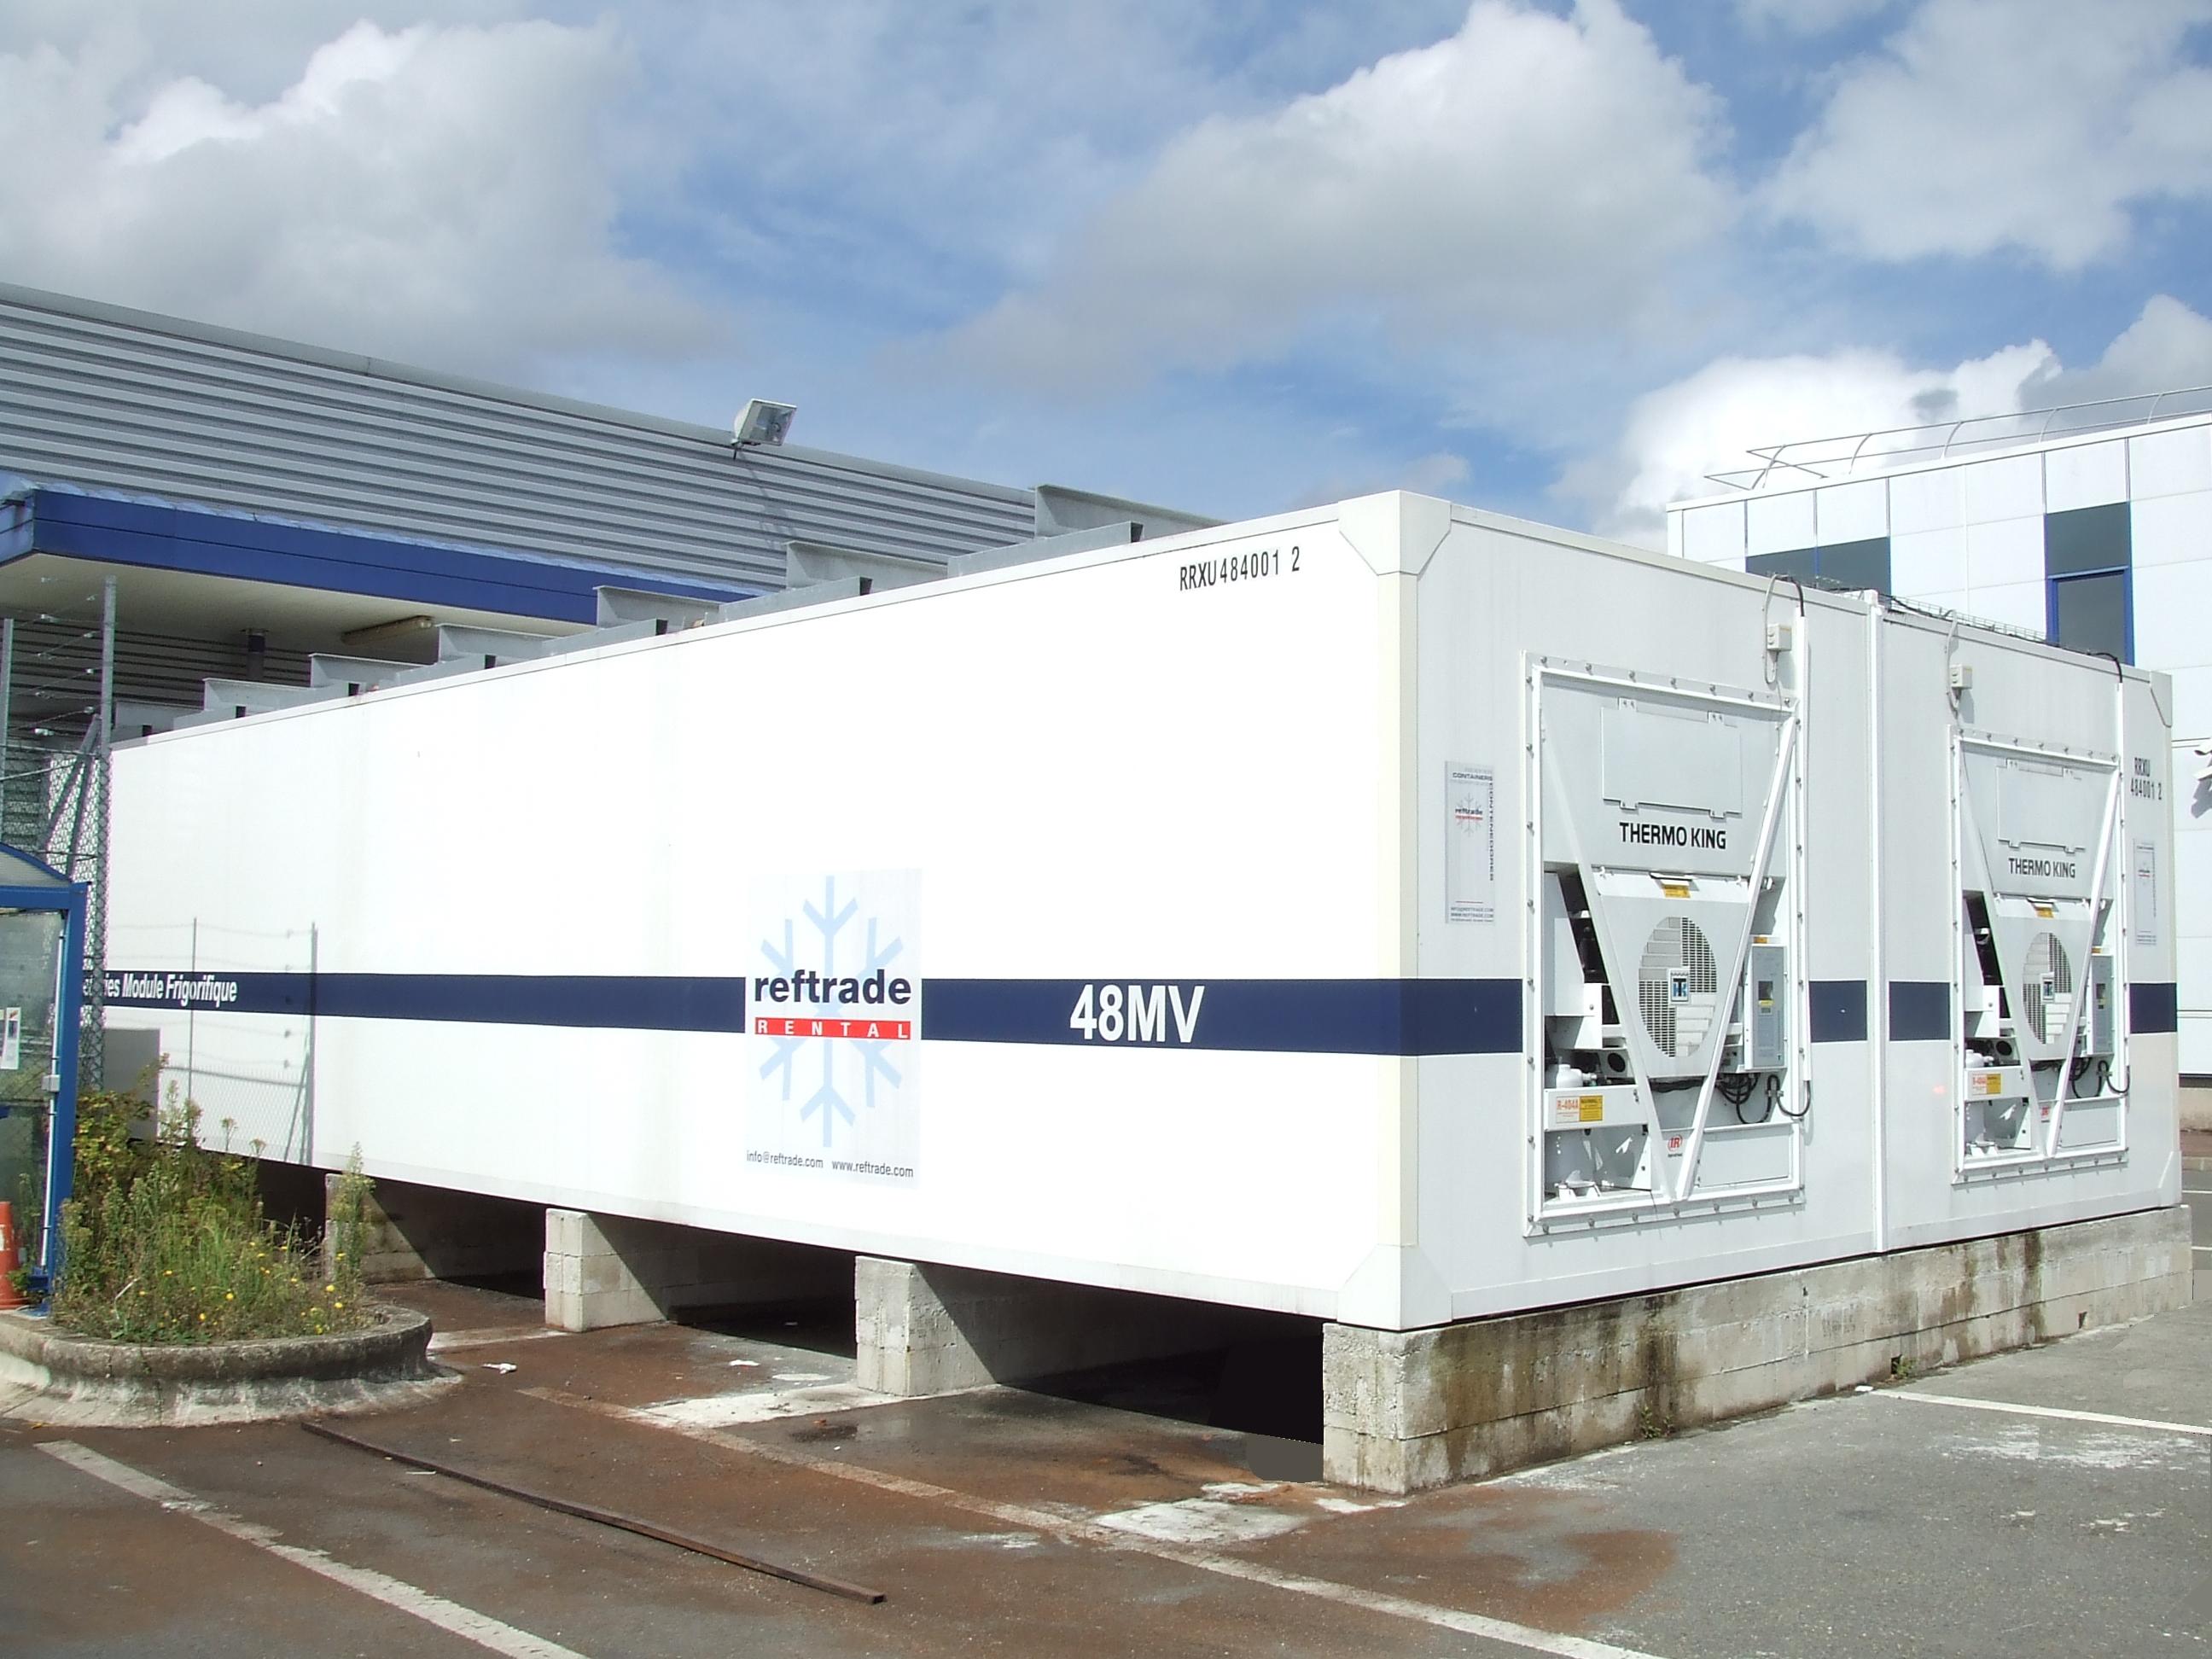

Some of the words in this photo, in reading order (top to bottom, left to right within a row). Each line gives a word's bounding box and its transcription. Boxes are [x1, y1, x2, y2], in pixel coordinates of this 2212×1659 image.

[1179, 560, 1216, 591] RRXU
[1220, 549, 1279, 584] 484001
[1291, 545, 1301, 573] 2
[1619, 821, 1688, 847] THERMO
[1690, 827, 1726, 850] KING
[2008, 857, 2052, 876] THERMO
[2052, 860, 2075, 879] KING
[121, 973, 165, 998] Module
[165, 973, 238, 1008] Frigorifique
[754, 969, 911, 1005] reftrade
[756, 1019, 909, 1039] RENTAL
[1069, 984, 1206, 1044] 48MV
[746, 1150, 824, 1168] info@reftrade.com
[831, 1159, 914, 1178] www.reftrade.com
